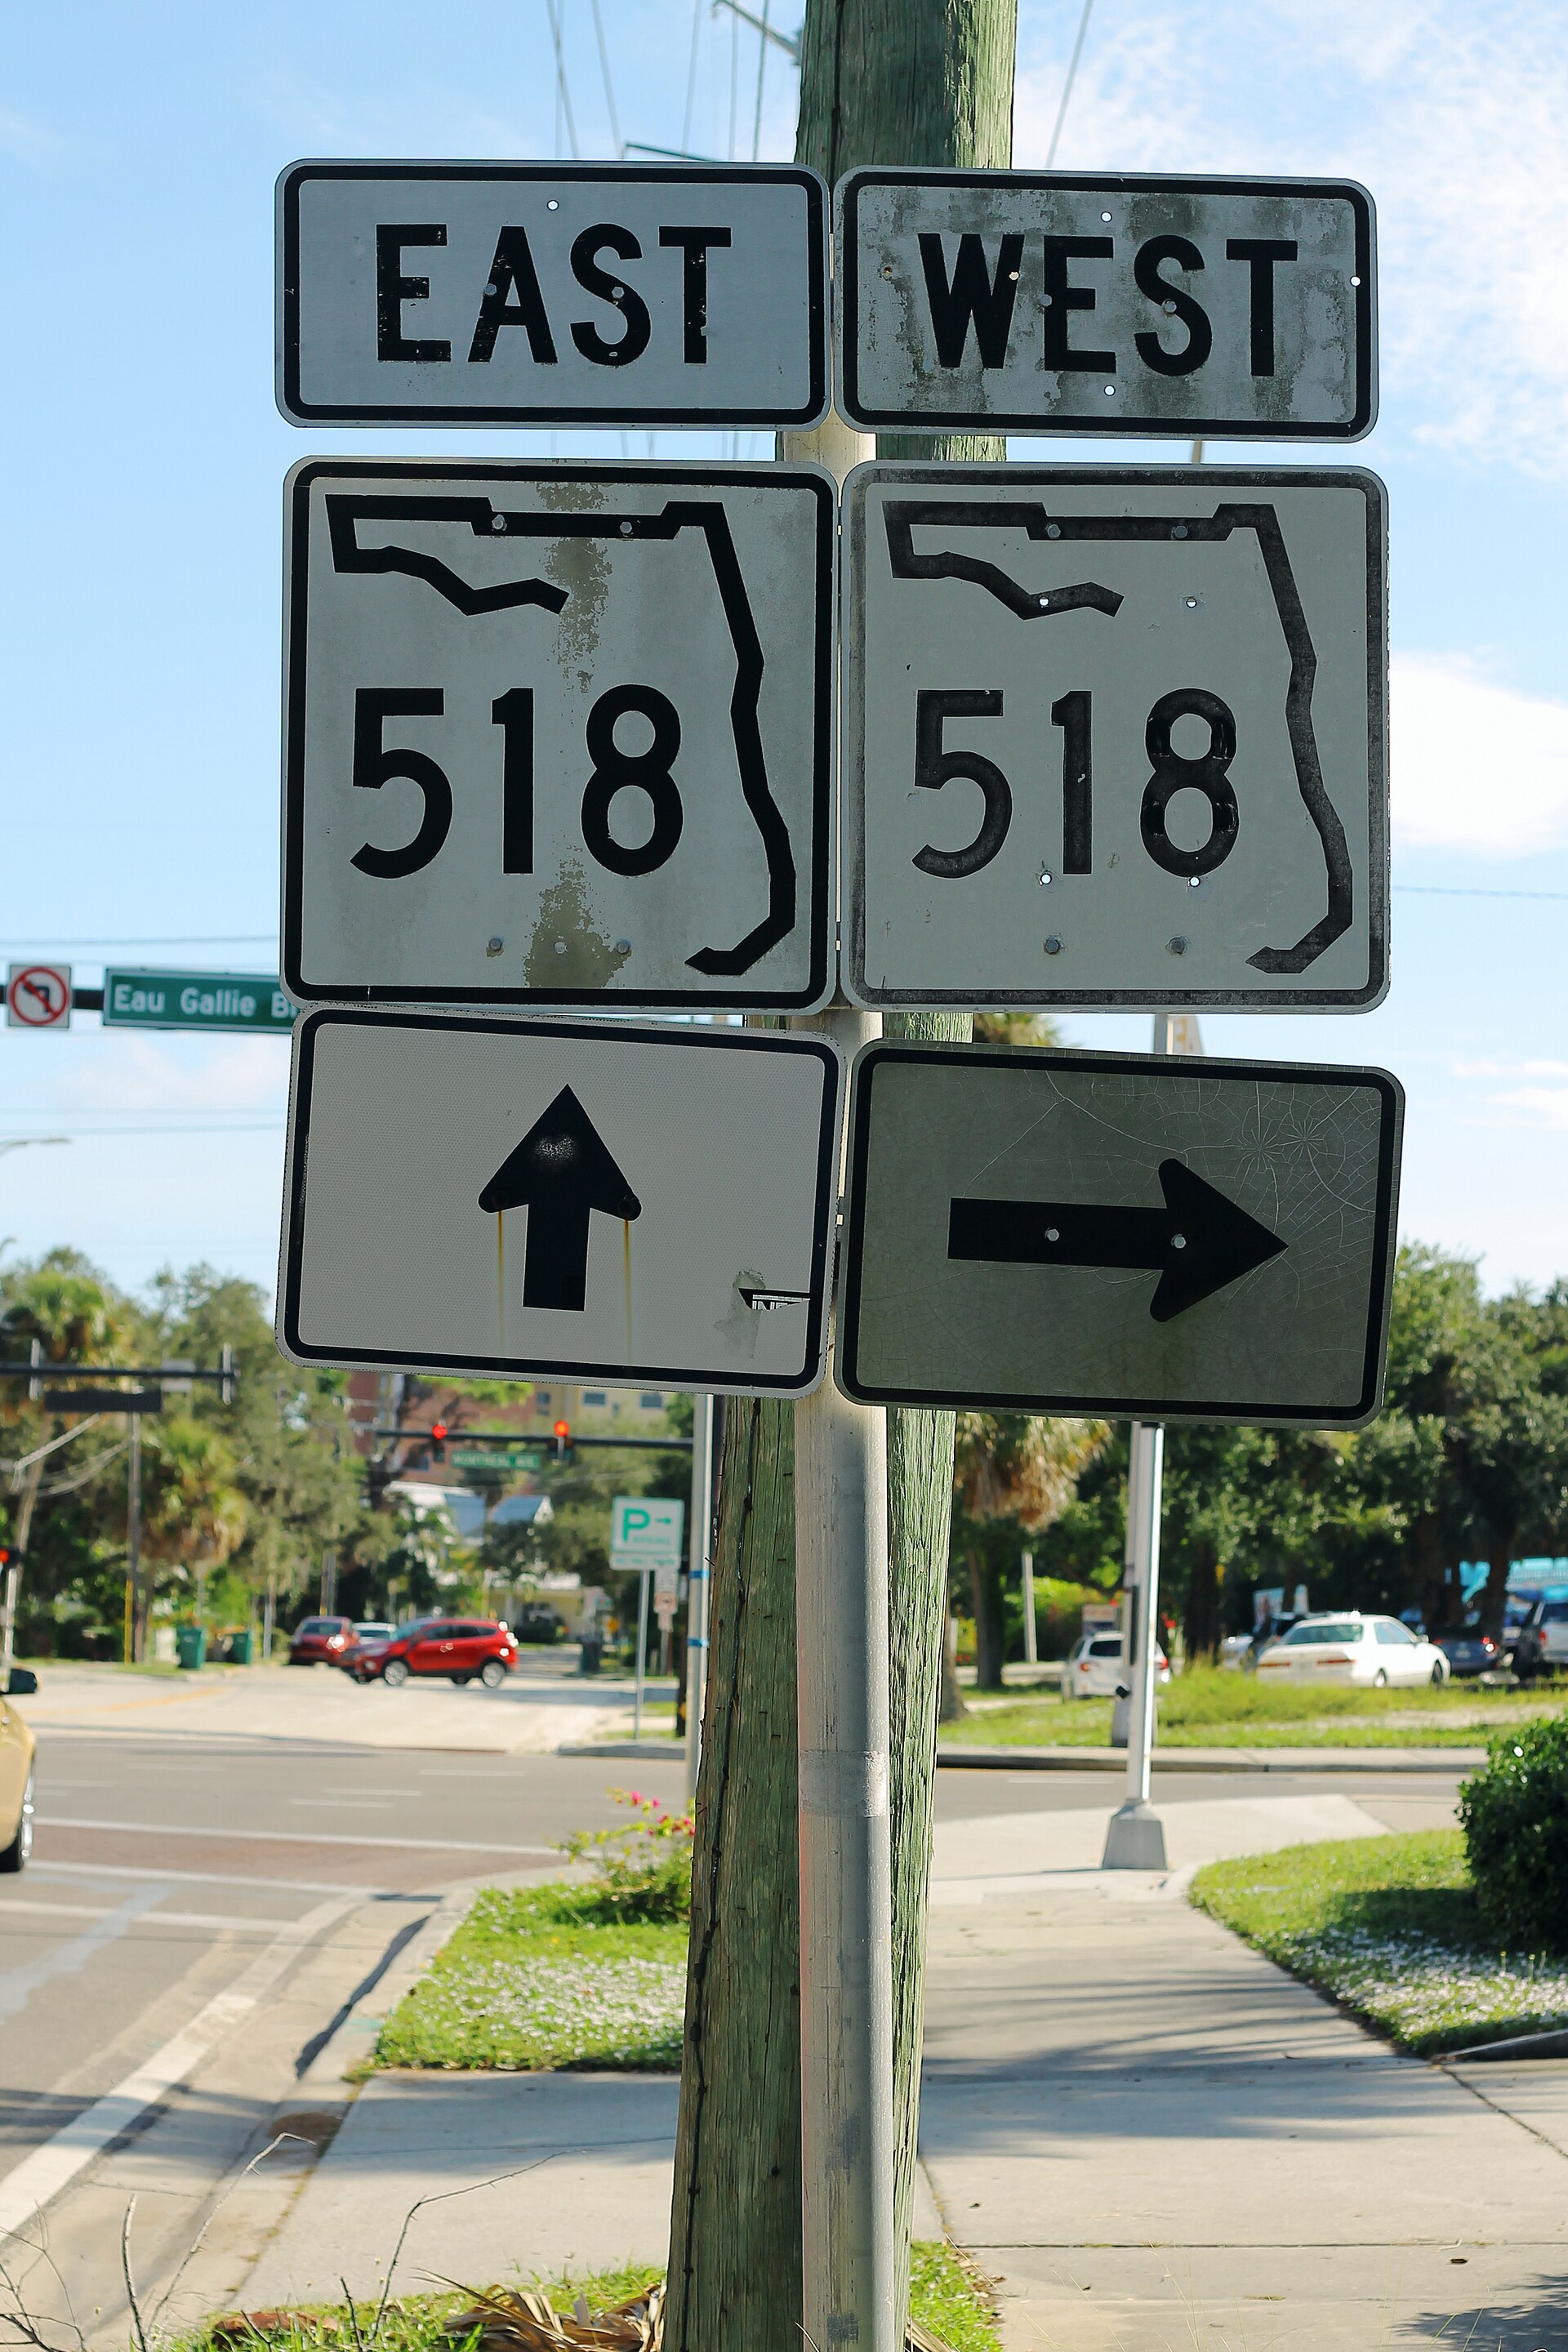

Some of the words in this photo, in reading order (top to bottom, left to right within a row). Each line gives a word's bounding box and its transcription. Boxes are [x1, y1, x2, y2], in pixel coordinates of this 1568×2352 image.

[376, 223, 733, 367] EAST
[916, 233, 1298, 379] WEST
[350, 684, 684, 880] 518
[911, 688, 1240, 880] 518
[114, 983, 165, 1013] Eau
[179, 986, 256, 1018] Gallie
